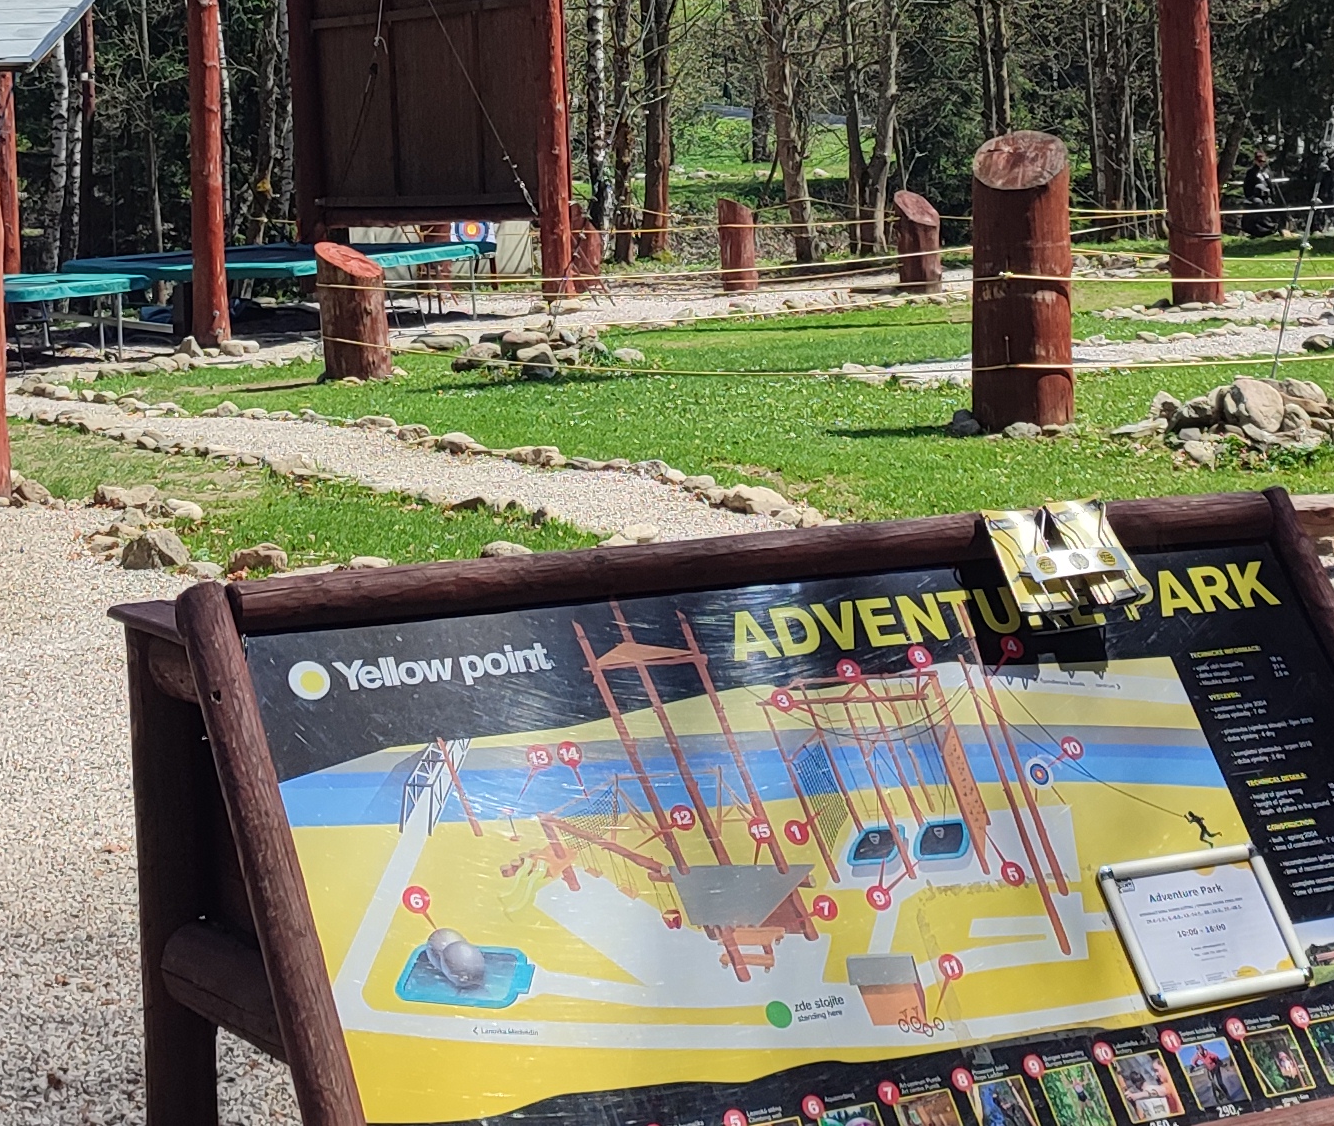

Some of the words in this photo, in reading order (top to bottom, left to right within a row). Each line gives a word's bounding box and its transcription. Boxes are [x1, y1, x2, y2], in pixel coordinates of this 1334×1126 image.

[733, 589, 1106, 661] ADVENTUE
[332, 657, 452, 691] Yellow
[459, 642, 551, 685] point
[842, 664, 856, 677] 2
[560, 747, 579, 761] 14
[1064, 740, 1080, 755] 10
[529, 751, 548, 765] 13
[672, 810, 693, 825] 12
[751, 825, 771, 839] 15
[791, 825, 802, 840] 1
[1149, 889, 1199, 903] Adventure
[1199, 883, 1224, 894] Park
[410, 894, 423, 908] 6
[819, 901, 830, 916] 7
[943, 961, 959, 975] 11
[1230, 1022, 1244, 1035] 12
[1164, 1034, 1179, 1048] 11
[1095, 1046, 1112, 1061] 10
[1028, 1057, 1040, 1070] 9
[957, 1073, 968, 1086] 8
[883, 1086, 892, 1101] 7
[808, 1101, 819, 1114] 6
[729, 1115, 741, 1126] 5
